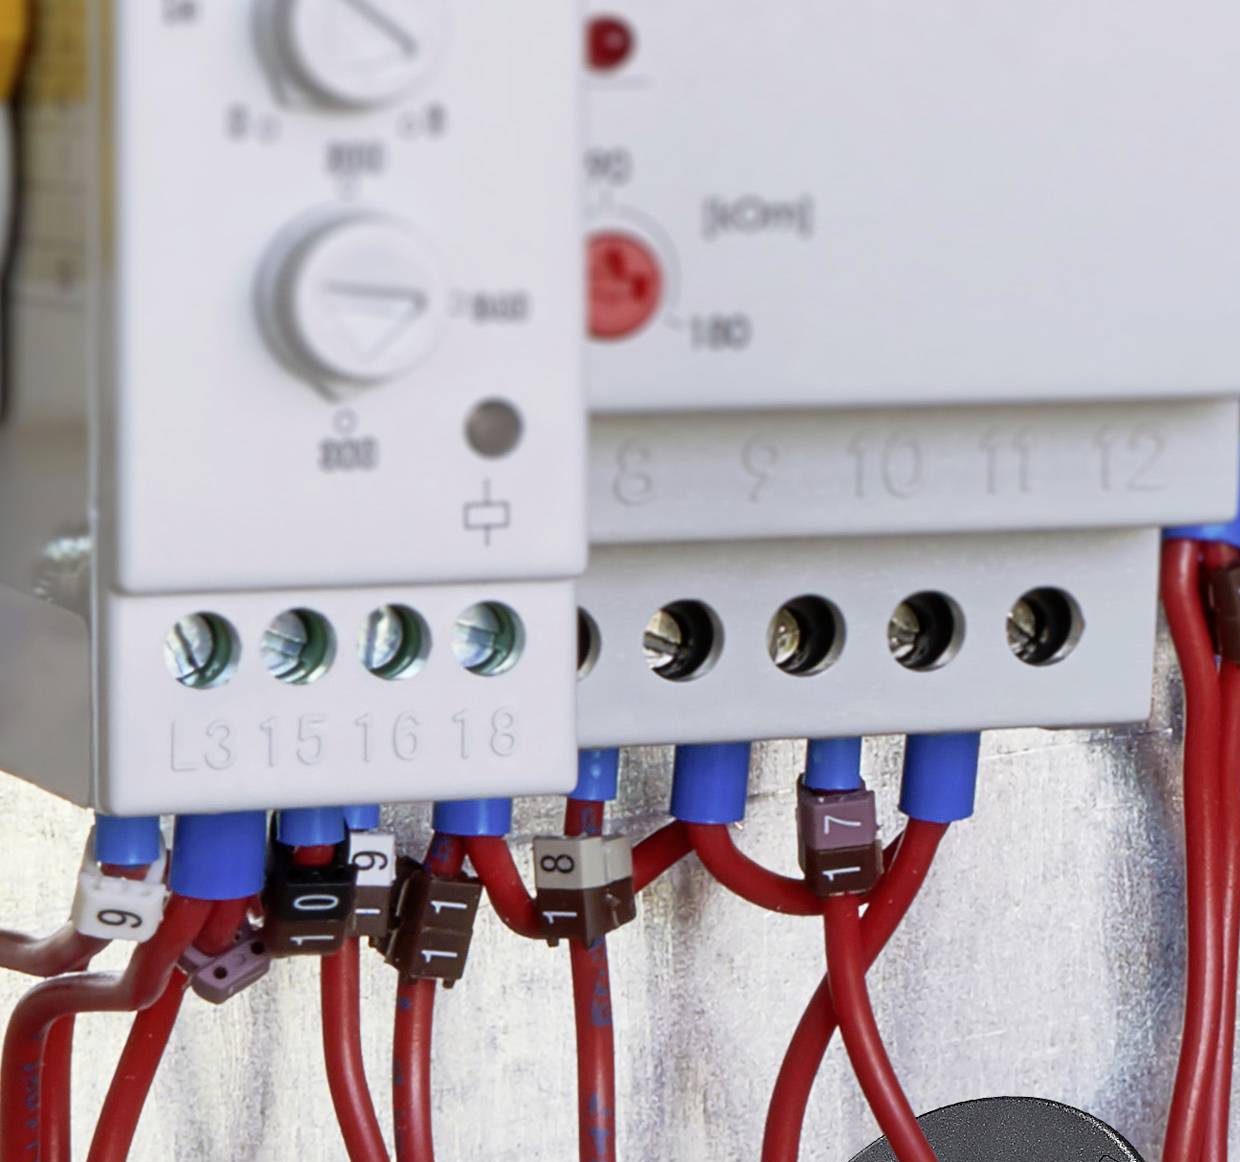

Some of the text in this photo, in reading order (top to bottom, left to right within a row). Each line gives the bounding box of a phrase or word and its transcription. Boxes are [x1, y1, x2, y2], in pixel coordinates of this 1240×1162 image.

[847, 432, 921, 498] 10
[980, 425, 1033, 496] 11
[1094, 425, 1165, 491] 12
[169, 706, 517, 772] L3 15 16 18
